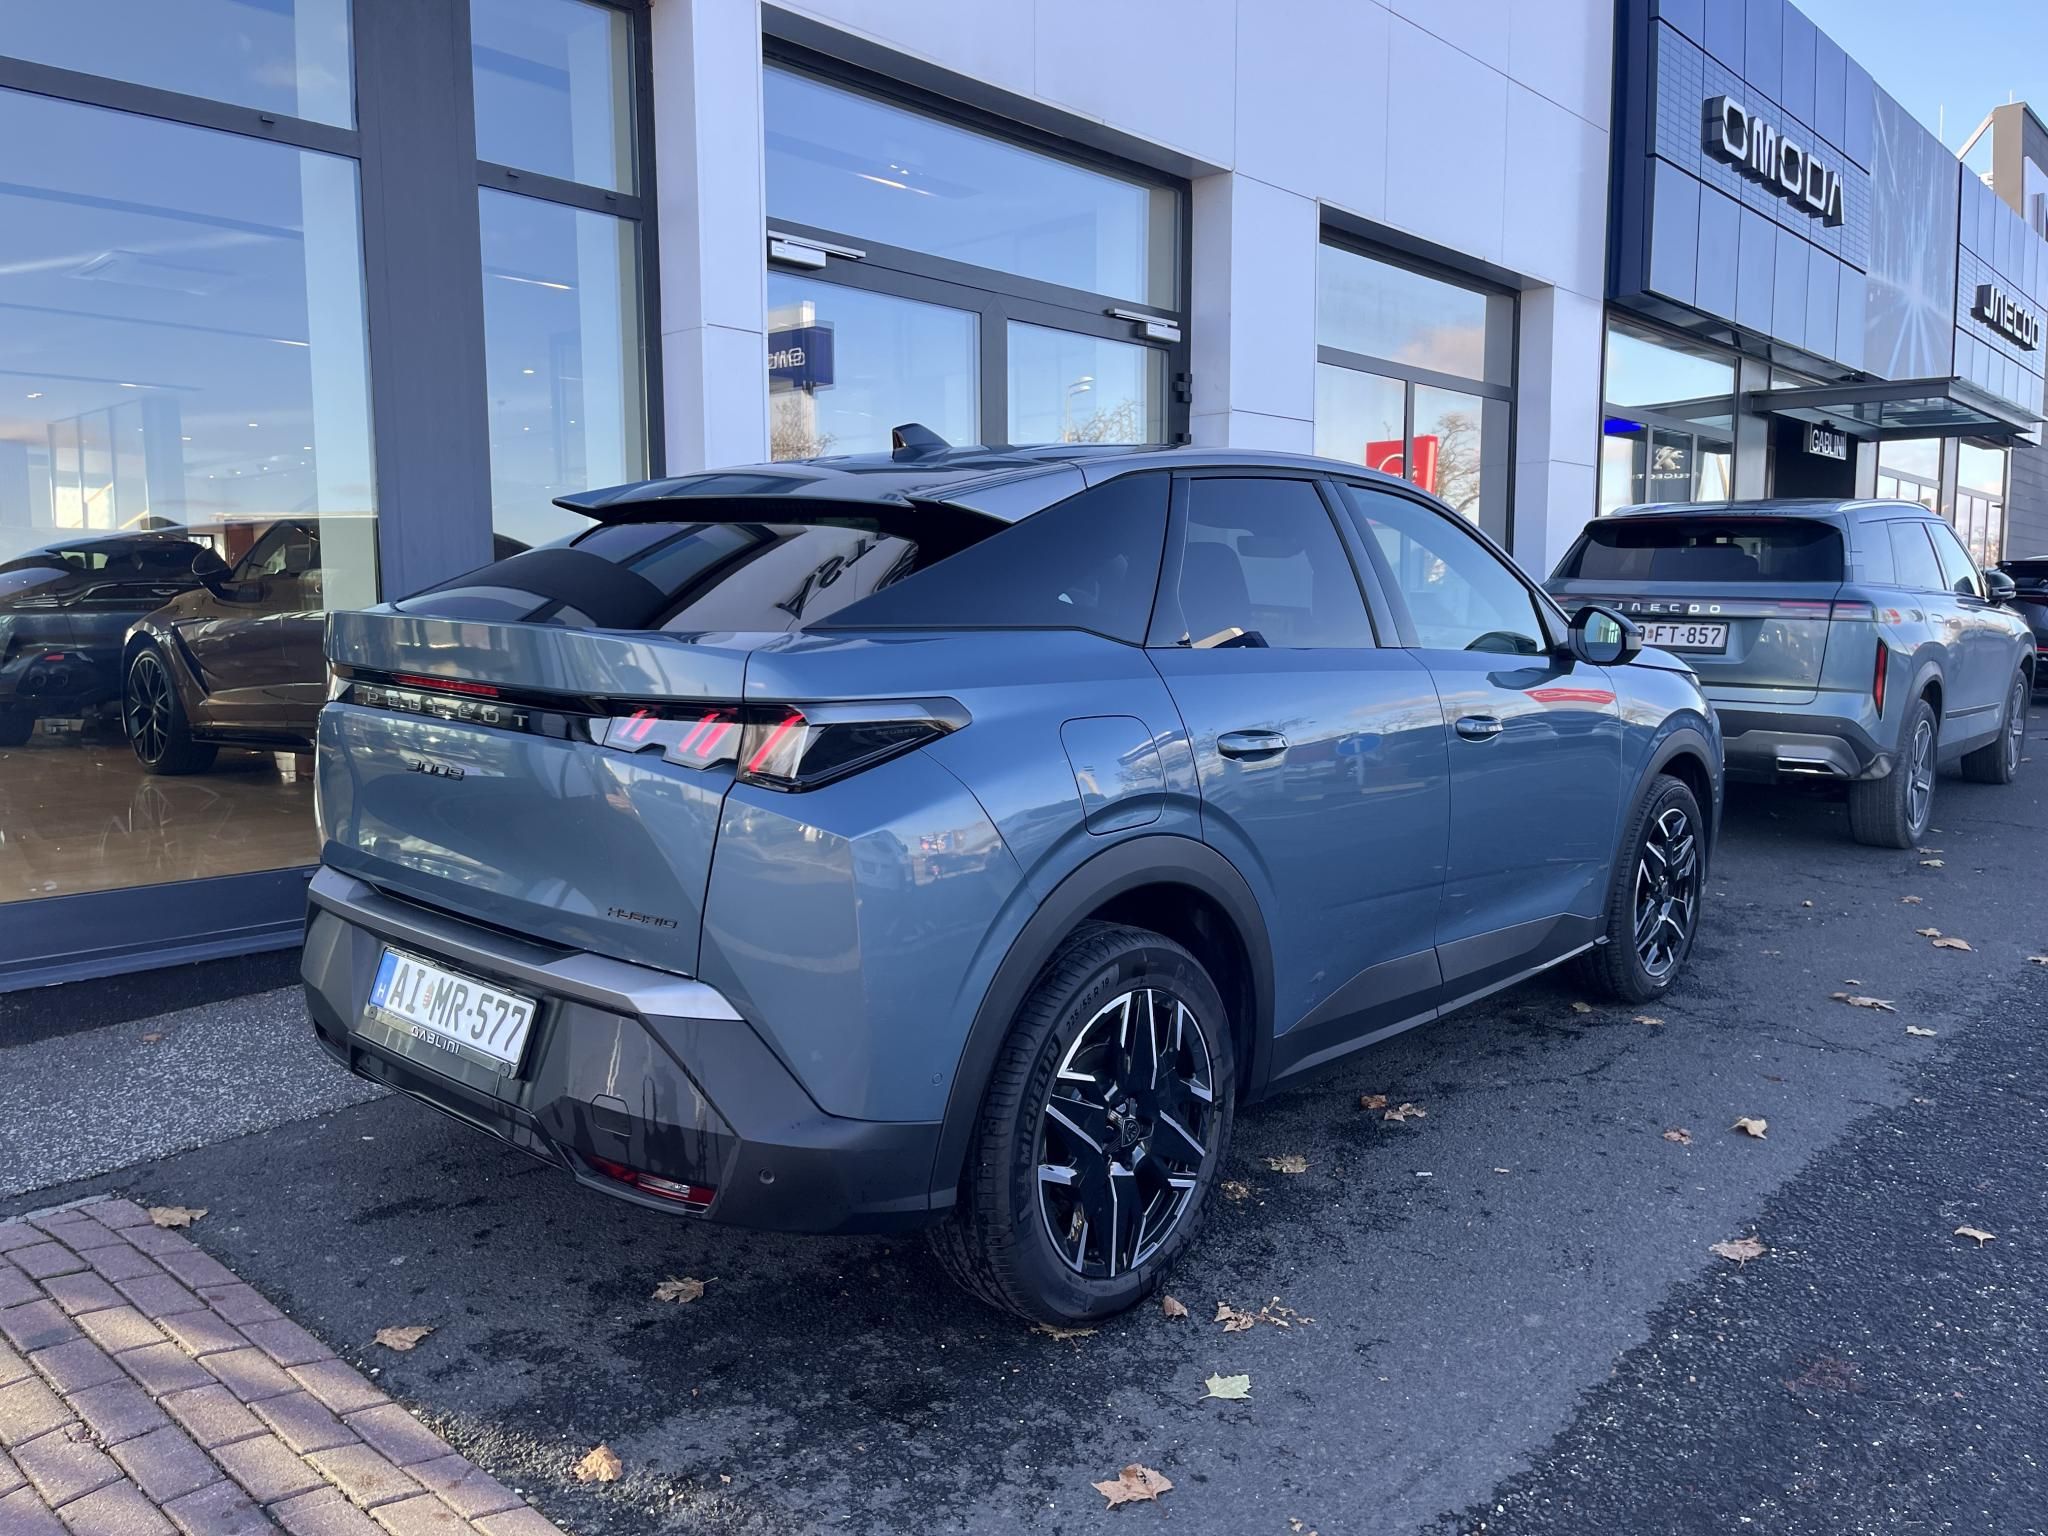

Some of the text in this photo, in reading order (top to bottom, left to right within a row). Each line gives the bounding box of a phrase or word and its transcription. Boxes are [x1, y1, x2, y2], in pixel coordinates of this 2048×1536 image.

[1721, 94, 1845, 226] OMODA
[1982, 284, 2040, 350] JAECOO
[1811, 428, 1845, 457] GABLINI
[1613, 602, 1721, 614] JAECOO
[1653, 625, 1722, 645] FT-857
[366, 691, 530, 727] PEUGEOT
[607, 906, 679, 929] HYBRID
[1065, 993, 1092, 1032] 225/55
[410, 1025, 461, 1055] GABLINI
[1020, 1039, 1060, 1166] MICHELIN
